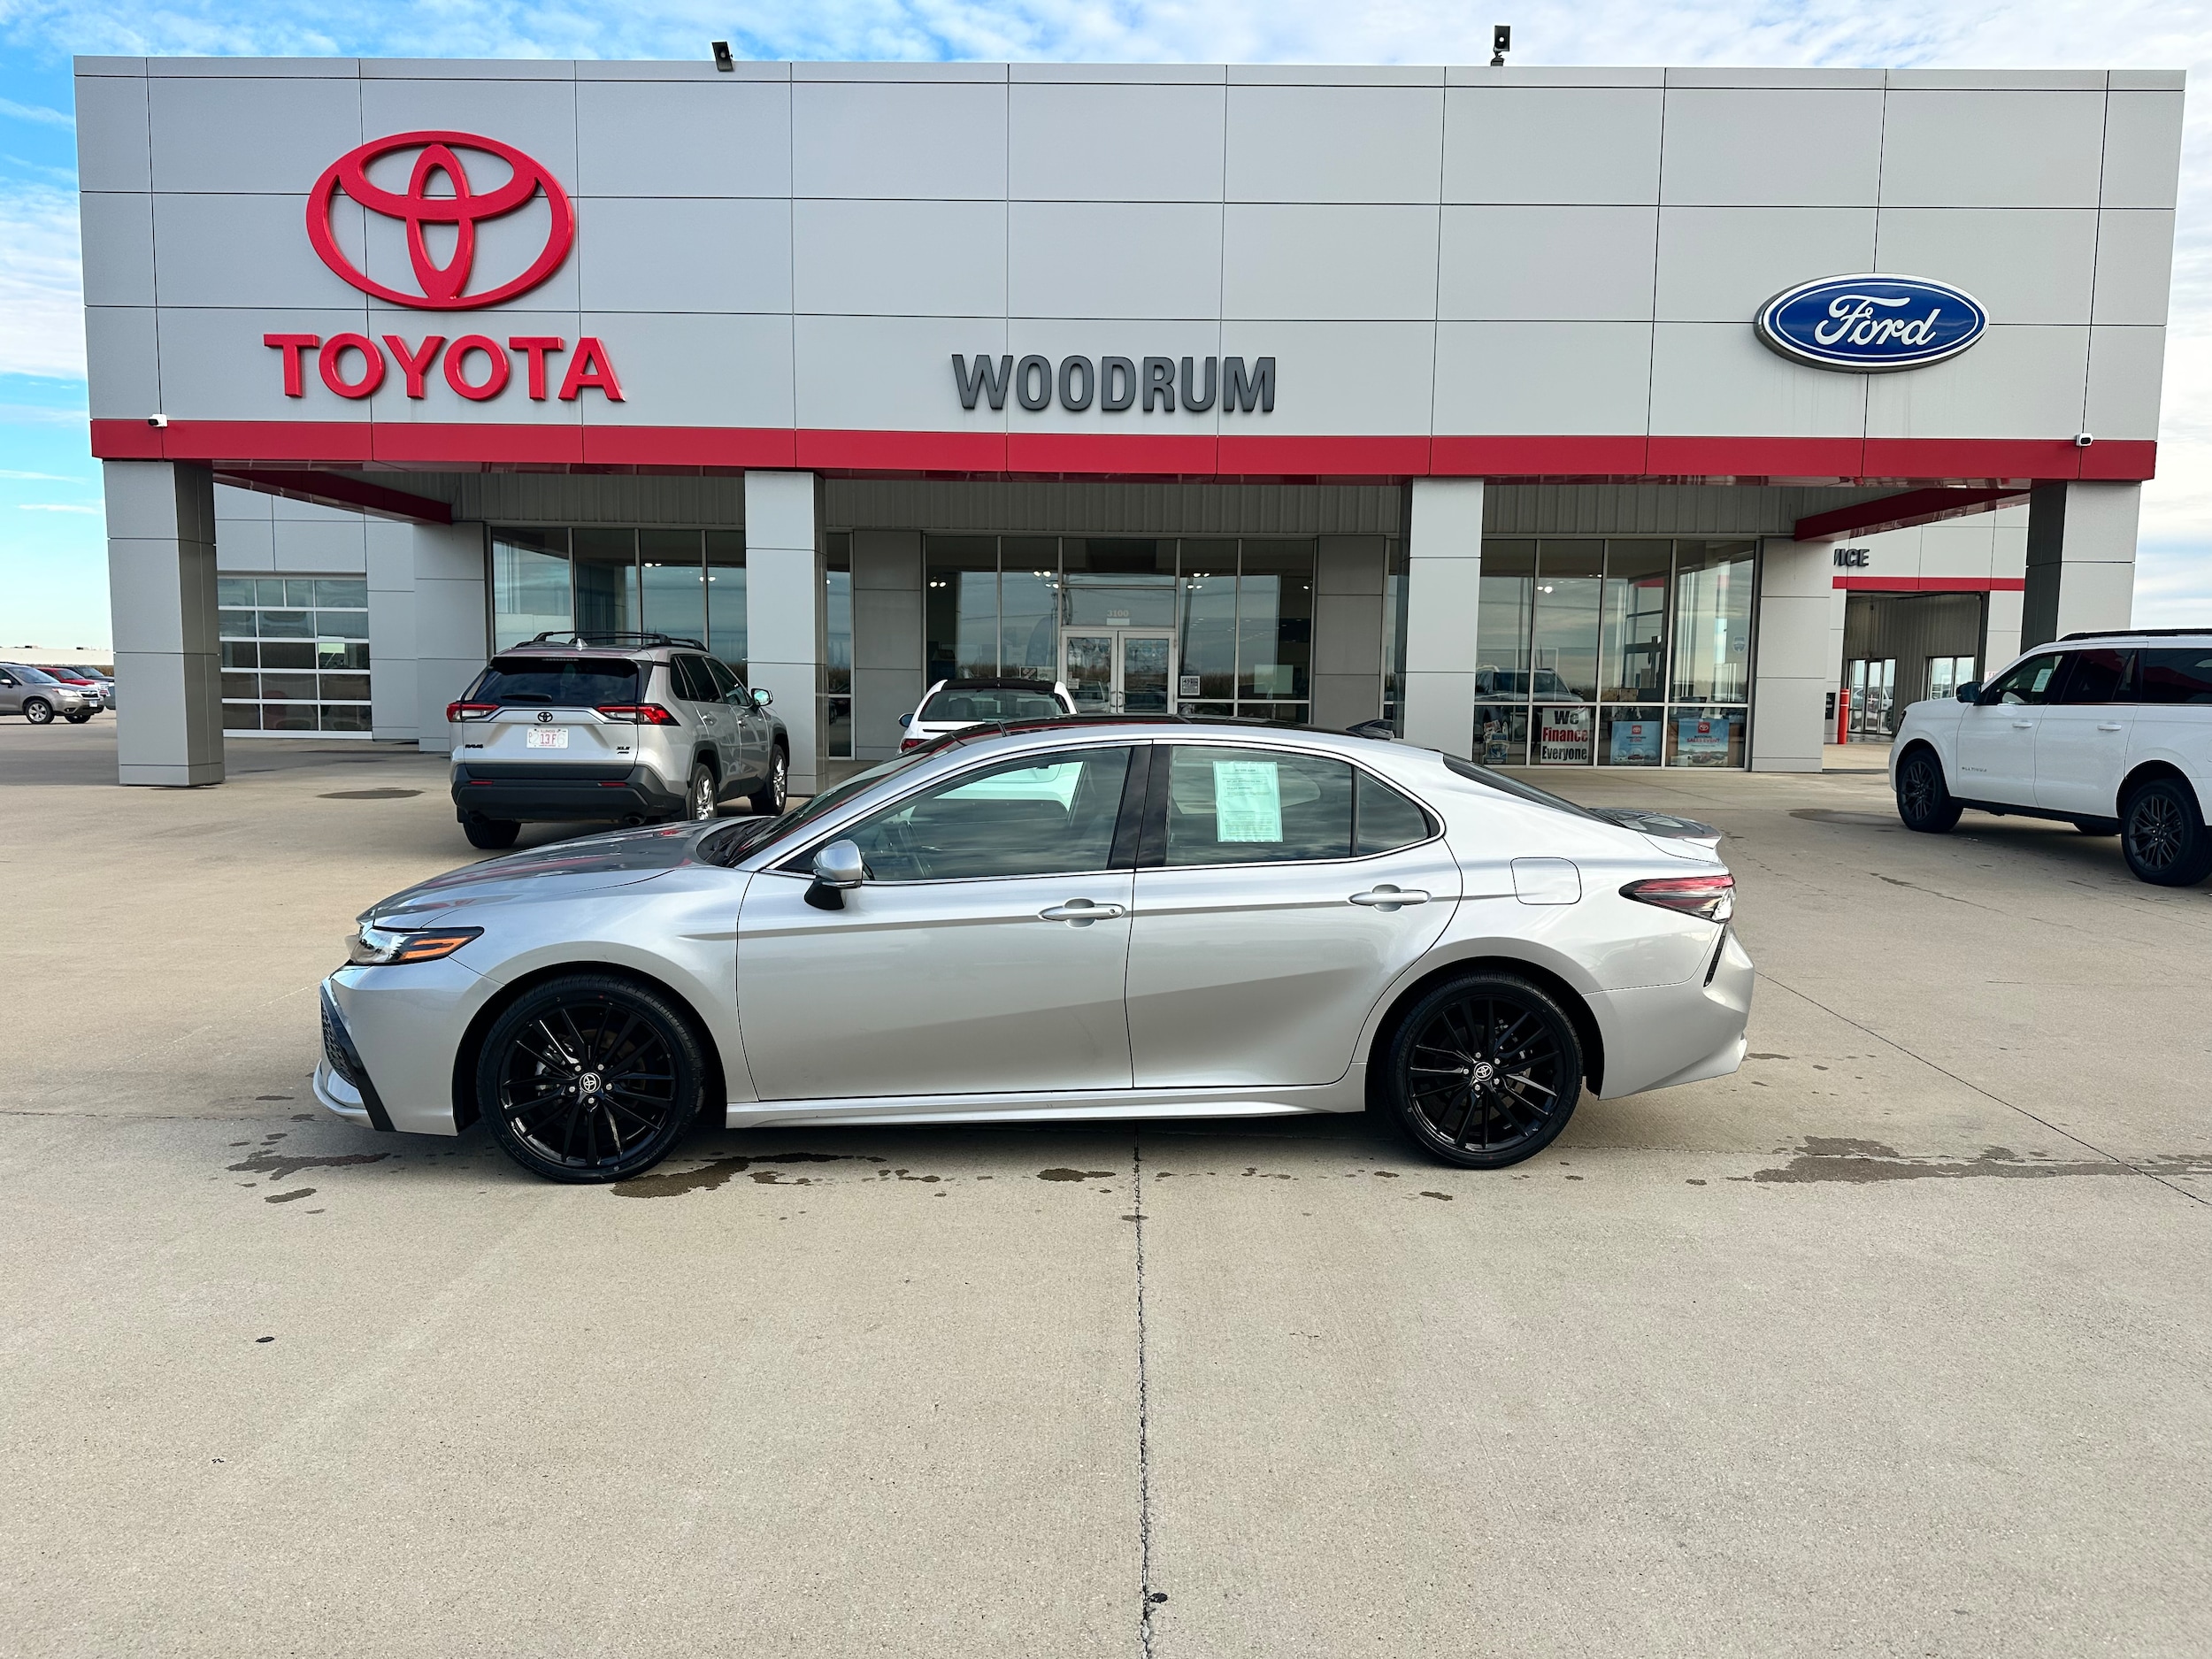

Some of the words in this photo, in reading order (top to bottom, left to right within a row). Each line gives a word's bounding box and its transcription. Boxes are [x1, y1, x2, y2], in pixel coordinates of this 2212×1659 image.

[1815, 294, 1941, 346] Ford
[264, 333, 625, 402] TOYOTA
[951, 354, 1276, 412] WOODRUM
[1554, 710, 1579, 725] We
[1542, 727, 1588, 742] Finance
[1541, 746, 1587, 761] Everyone
